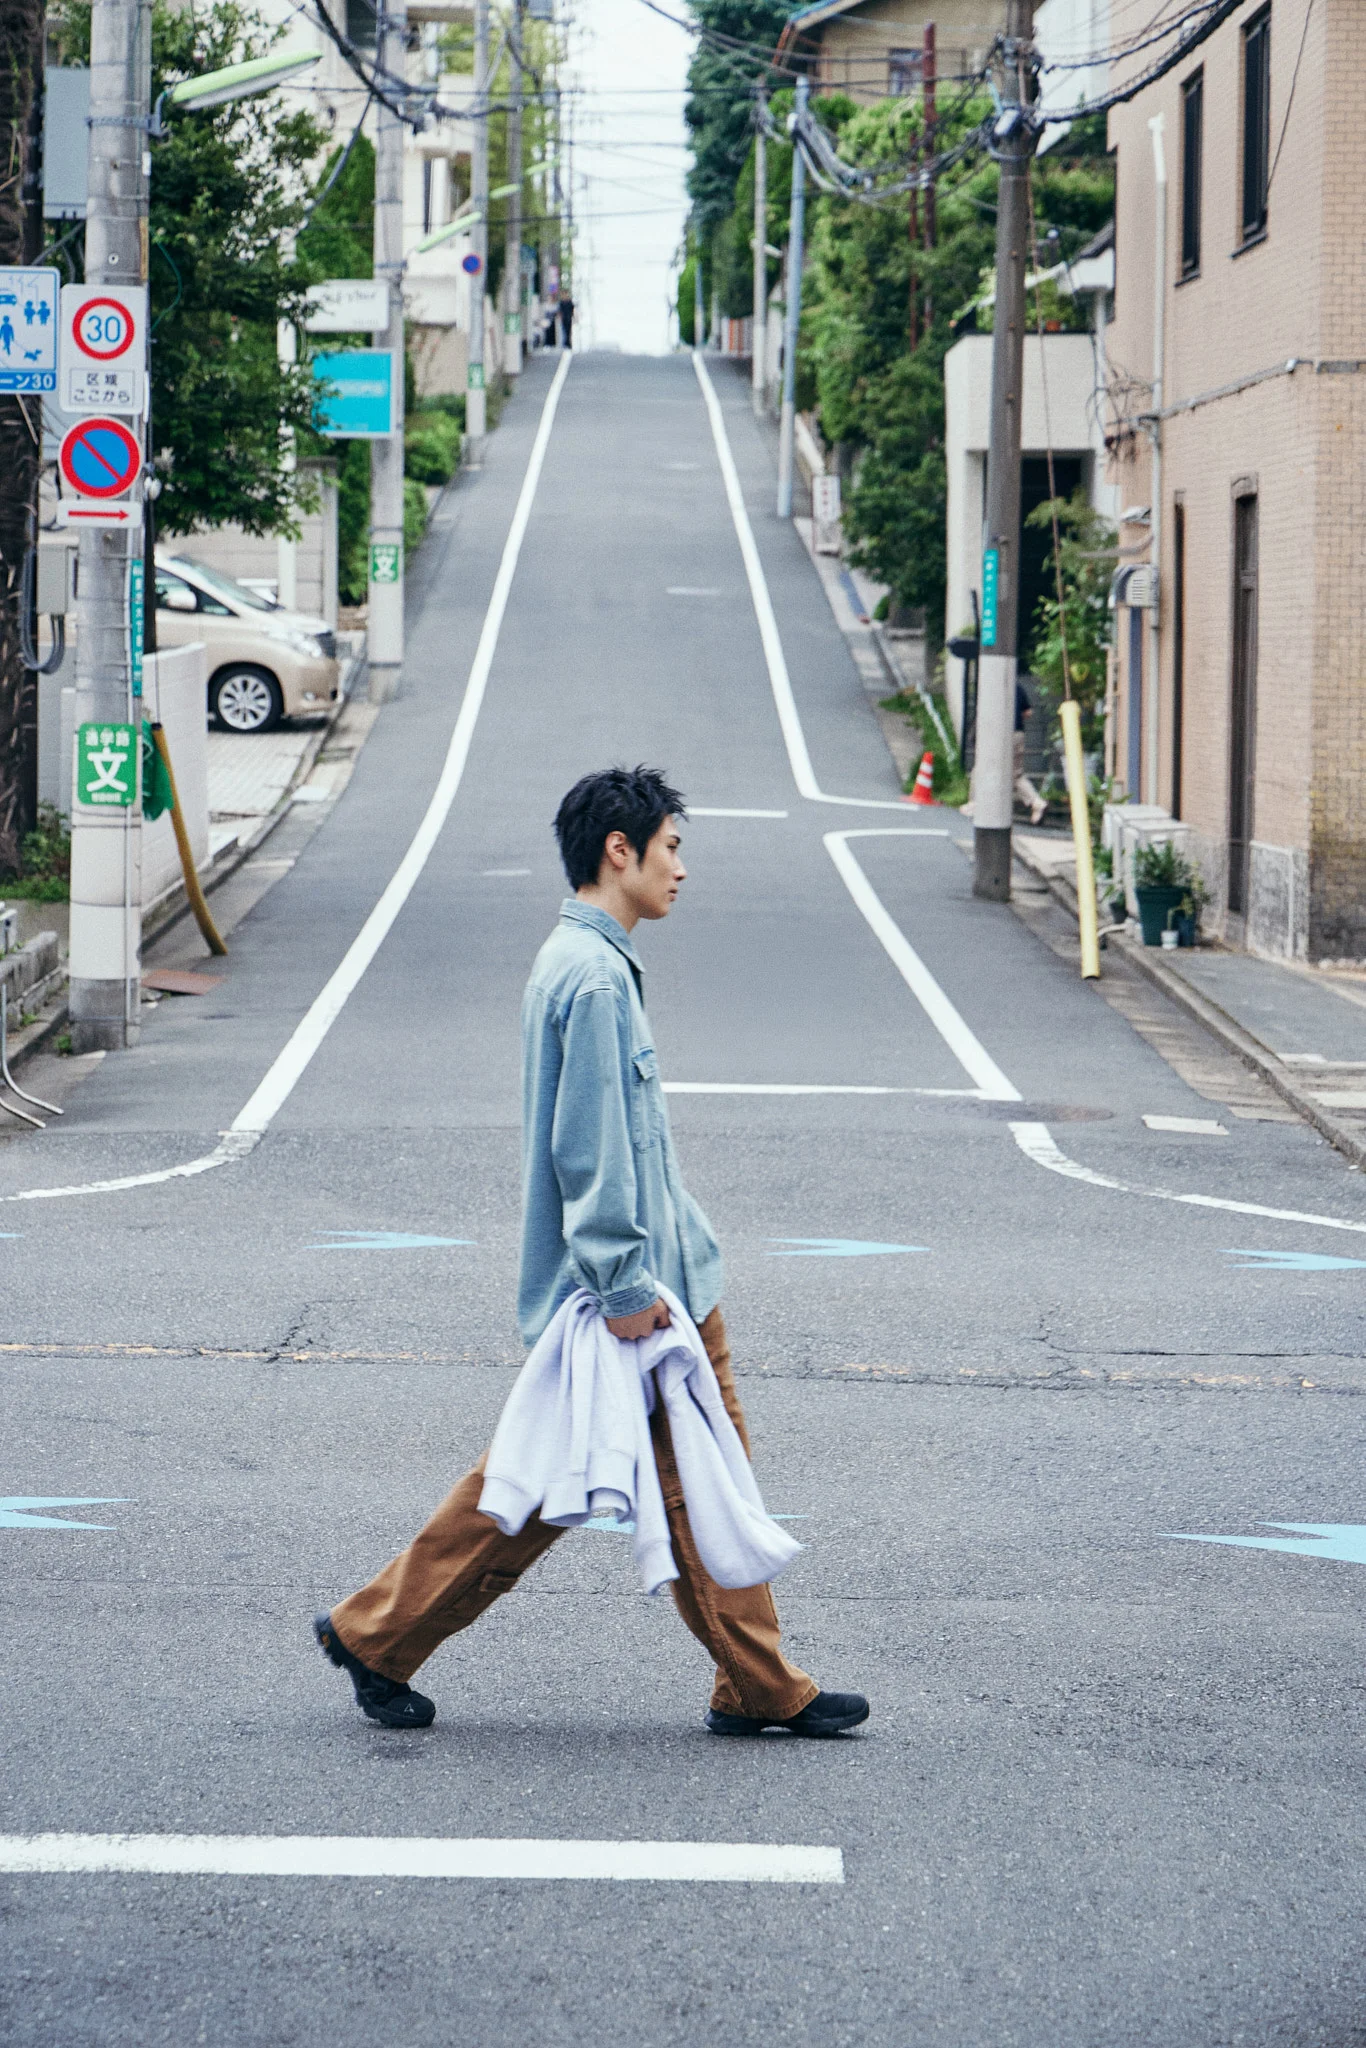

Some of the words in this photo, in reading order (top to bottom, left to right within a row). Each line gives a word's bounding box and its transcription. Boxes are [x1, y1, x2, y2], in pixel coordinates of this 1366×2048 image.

[87, 315, 120, 343] 30
[74, 388, 130, 403] ここから
[86, 745, 128, 793] 文
